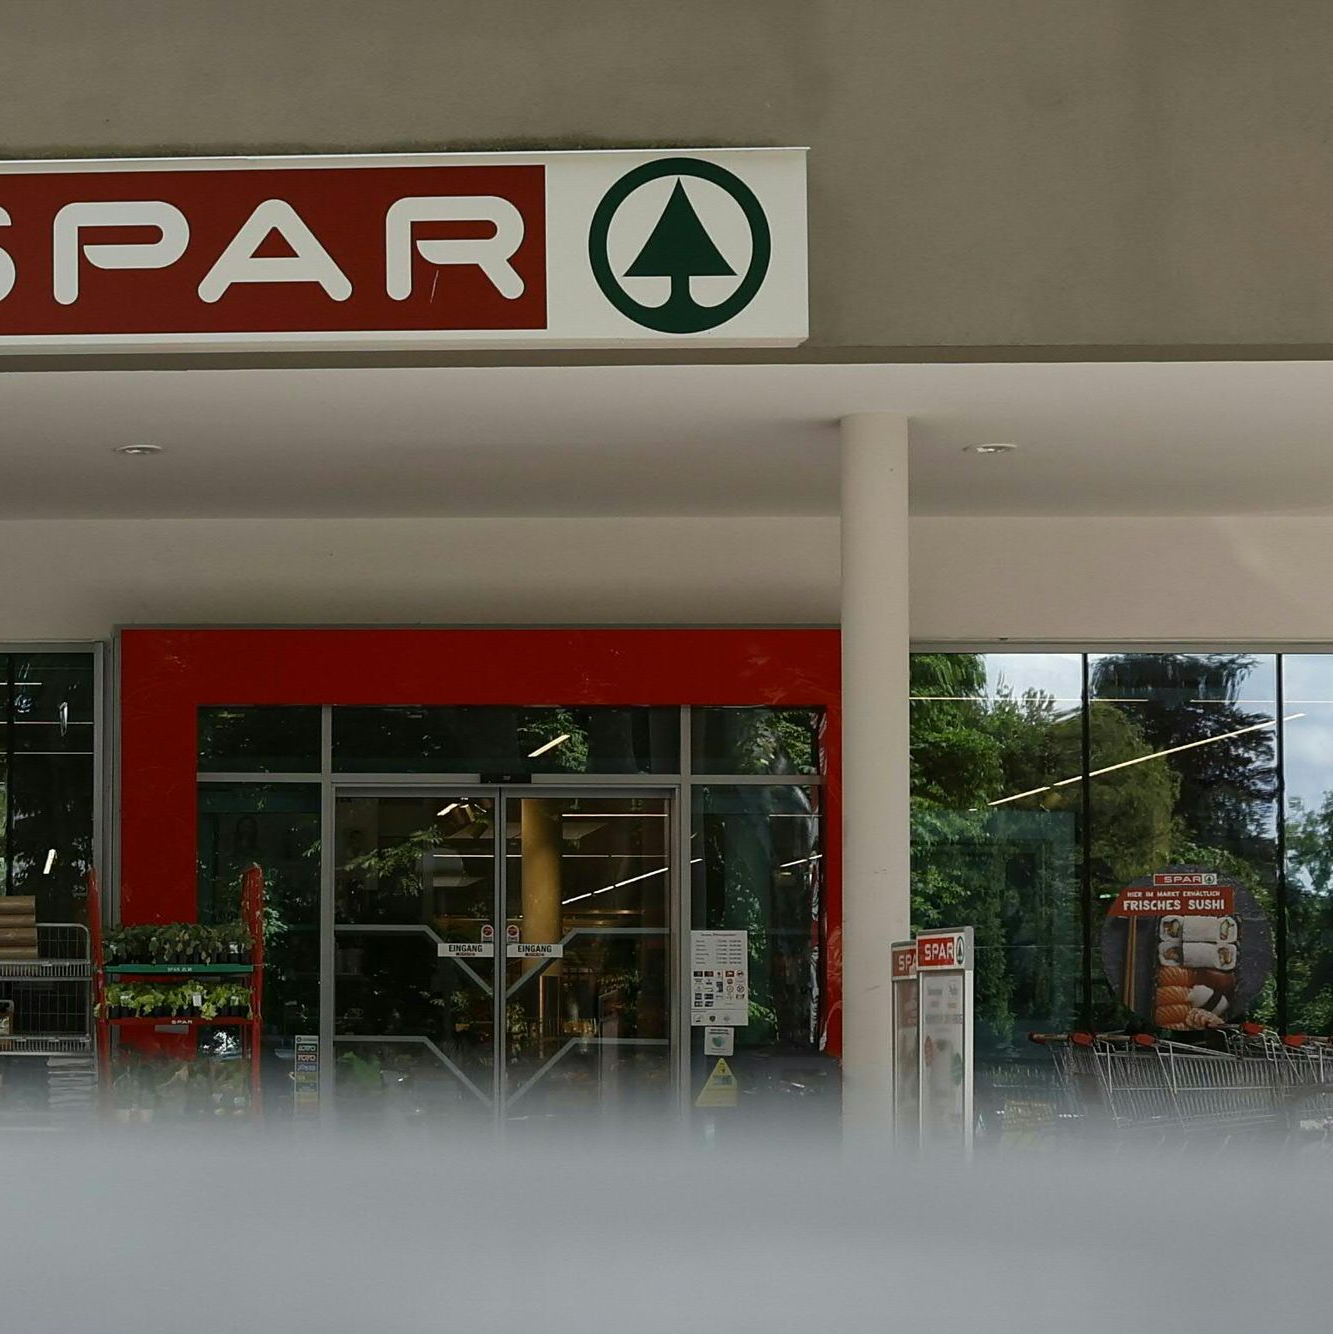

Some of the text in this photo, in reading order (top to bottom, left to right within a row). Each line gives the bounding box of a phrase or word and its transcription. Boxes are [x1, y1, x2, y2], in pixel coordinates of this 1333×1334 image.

[1164, 875, 1202, 883] SPAR
[1123, 899, 1225, 911] FRISCHES SUSHI
[448, 944, 483, 953] EINGANG
[517, 945, 552, 953] EINGANG
[924, 942, 954, 961] SPAR
